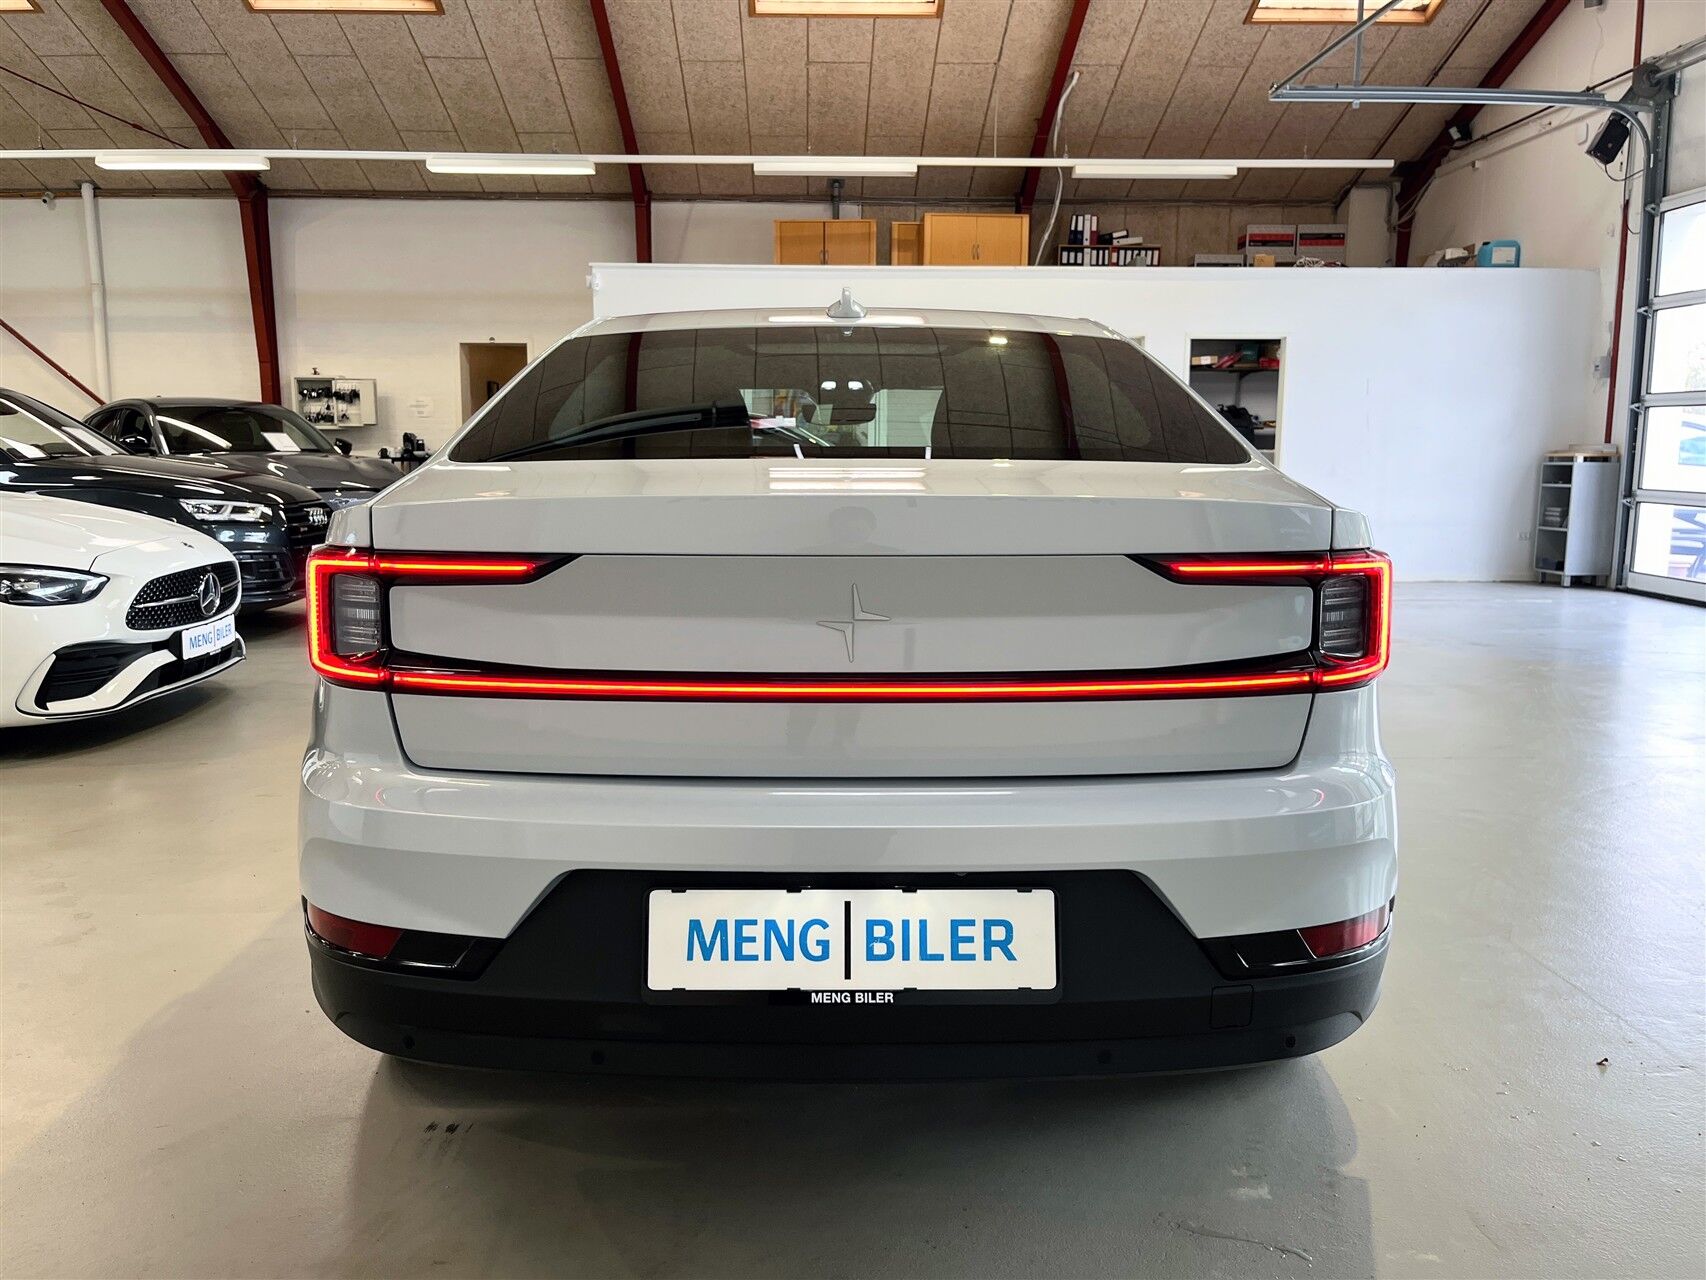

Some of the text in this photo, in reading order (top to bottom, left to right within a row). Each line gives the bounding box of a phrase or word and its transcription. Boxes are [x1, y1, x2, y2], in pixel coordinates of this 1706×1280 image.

[190, 631, 213, 650] MENG
[685, 918, 1018, 962] MENG BILER
[811, 992, 894, 1003] MENG BILER
